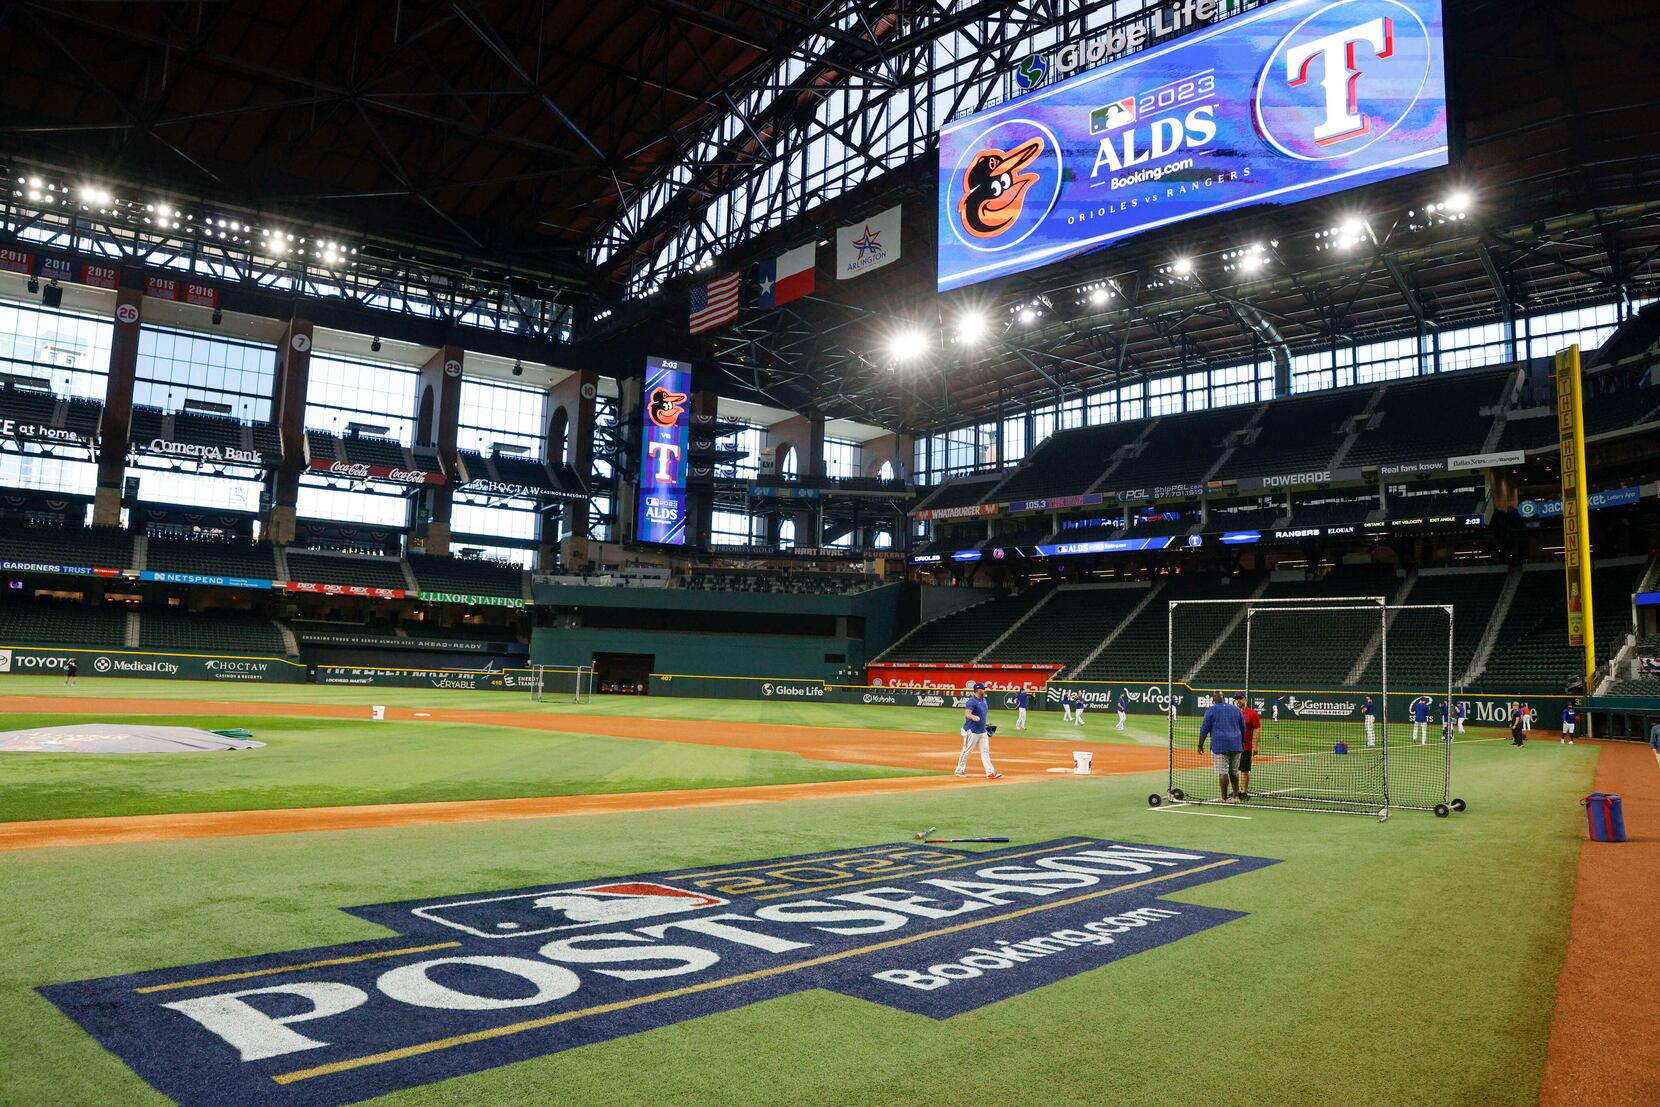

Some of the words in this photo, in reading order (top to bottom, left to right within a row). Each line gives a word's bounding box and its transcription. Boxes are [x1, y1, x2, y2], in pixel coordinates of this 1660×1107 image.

[1056, 23, 1147, 74] Globe
[1155, 0, 1217, 39] Life
[1139, 75, 1215, 114] 2023
[1090, 105, 1218, 179] ALDS
[1111, 158, 1194, 190] Booking.com
[1068, 198, 1139, 225] ORIOLES
[1167, 167, 1252, 198] RANGERS
[44, 257, 72, 272] 2011
[846, 250, 888, 272] ARLINGTON
[87, 265, 115, 280] 2012
[148, 277, 175, 291] 2015
[188, 284, 214, 299] 2016
[118, 306, 137, 321] 26
[297, 336, 306, 349] 7
[446, 362, 461, 375] 29
[661, 360, 678, 370] 2:03
[19, 424, 36, 434] at
[39, 425, 77, 439] home
[224, 446, 263, 463] Bank
[1381, 465, 1399, 475] Real
[1400, 464, 1418, 473] fans
[1420, 461, 1444, 472] know.
[1262, 471, 1331, 488] POWERADE
[1125, 488, 1150, 499] PGL
[1025, 499, 1047, 510] 105.3
[645, 506, 679, 521] ALDS
[931, 506, 980, 519] WHATABURGER
[1464, 518, 1480, 526] 2:03
[1275, 529, 1320, 539] RANGERS
[3, 561, 61, 573] GARDENERS
[62, 565, 92, 575] TRUST
[167, 574, 224, 585] NETSPEND
[297, 582, 316, 590] DEX
[429, 592, 469, 604] LUXOR
[471, 595, 523, 608] STAFFING
[15, 656, 69, 668] TOYOT
[113, 660, 156, 672] Medical
[157, 661, 179, 673] City
[211, 660, 268, 671] CHOCTAW
[776, 684, 804, 695] Globe
[806, 685, 824, 696] Life
[872, 694, 896, 703] Kubota
[1304, 699, 1355, 710] Germania
[694, 850, 963, 896] 2023
[160, 844, 1207, 1063] POSTSEASON
[871, 908, 1181, 992] Booking.com
